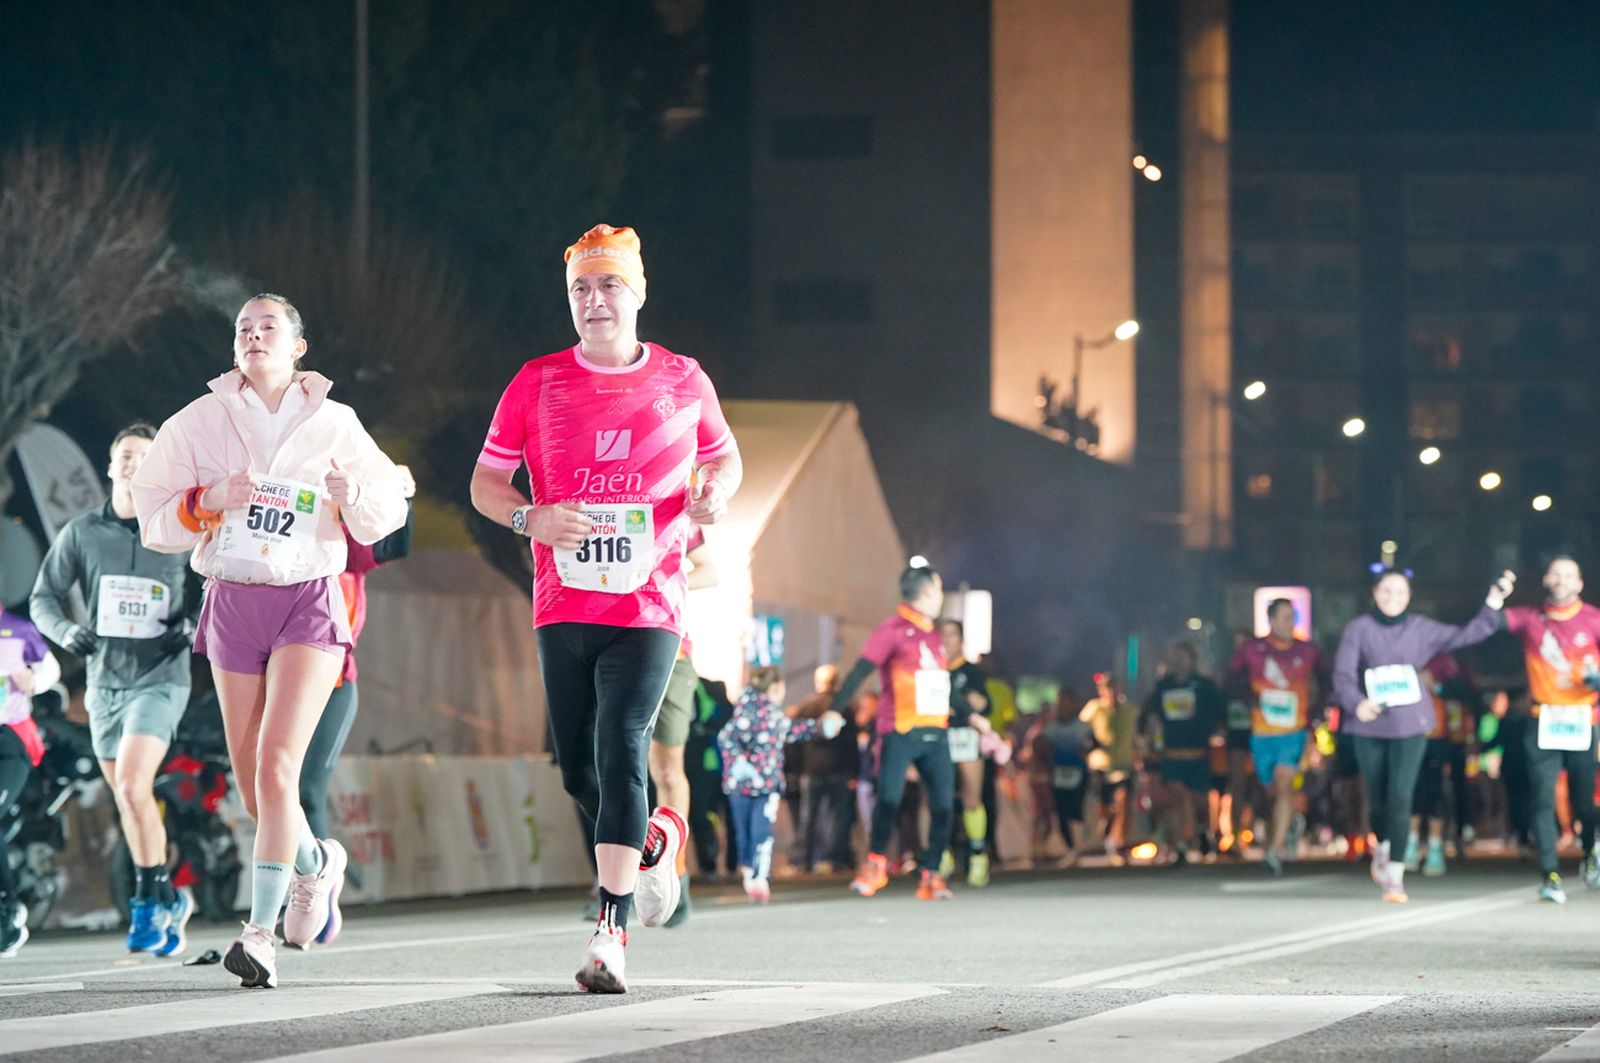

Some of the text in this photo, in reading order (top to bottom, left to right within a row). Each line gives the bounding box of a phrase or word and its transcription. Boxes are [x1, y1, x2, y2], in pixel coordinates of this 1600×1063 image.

[571, 466, 643, 496] Jaén
[279, 487, 290, 497] DE
[602, 494, 651, 504] INTERIOR
[247, 504, 295, 537] 502
[605, 514, 616, 523] DE
[576, 537, 631, 563] 3116
[119, 601, 147, 617] 6131
